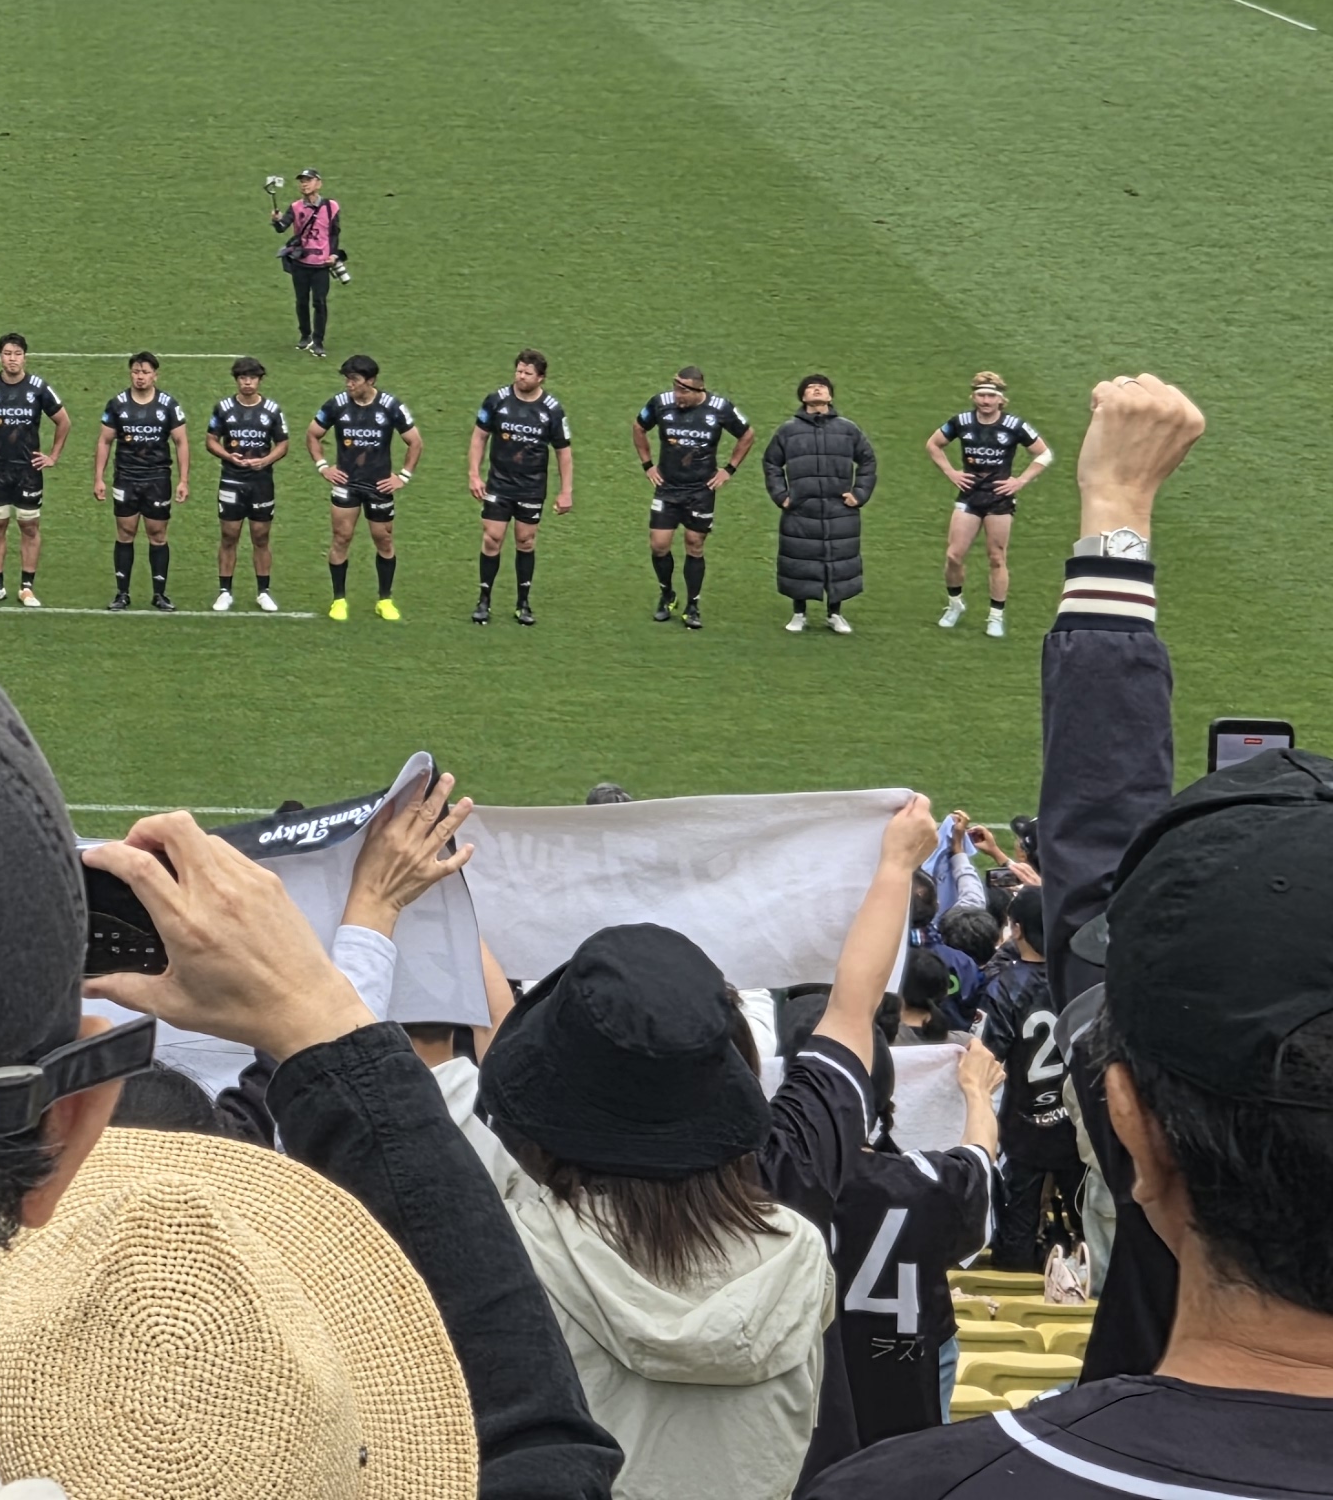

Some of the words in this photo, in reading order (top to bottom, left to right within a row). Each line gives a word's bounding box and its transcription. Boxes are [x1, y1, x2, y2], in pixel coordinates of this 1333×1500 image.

[122, 425, 162, 434] RICOH
[343, 428, 382, 438] RICOH
[501, 421, 542, 435] RICOH
[229, 429, 267, 438] RICOH
[666, 428, 712, 439] RICOH
[964, 446, 1005, 456] RICOH
